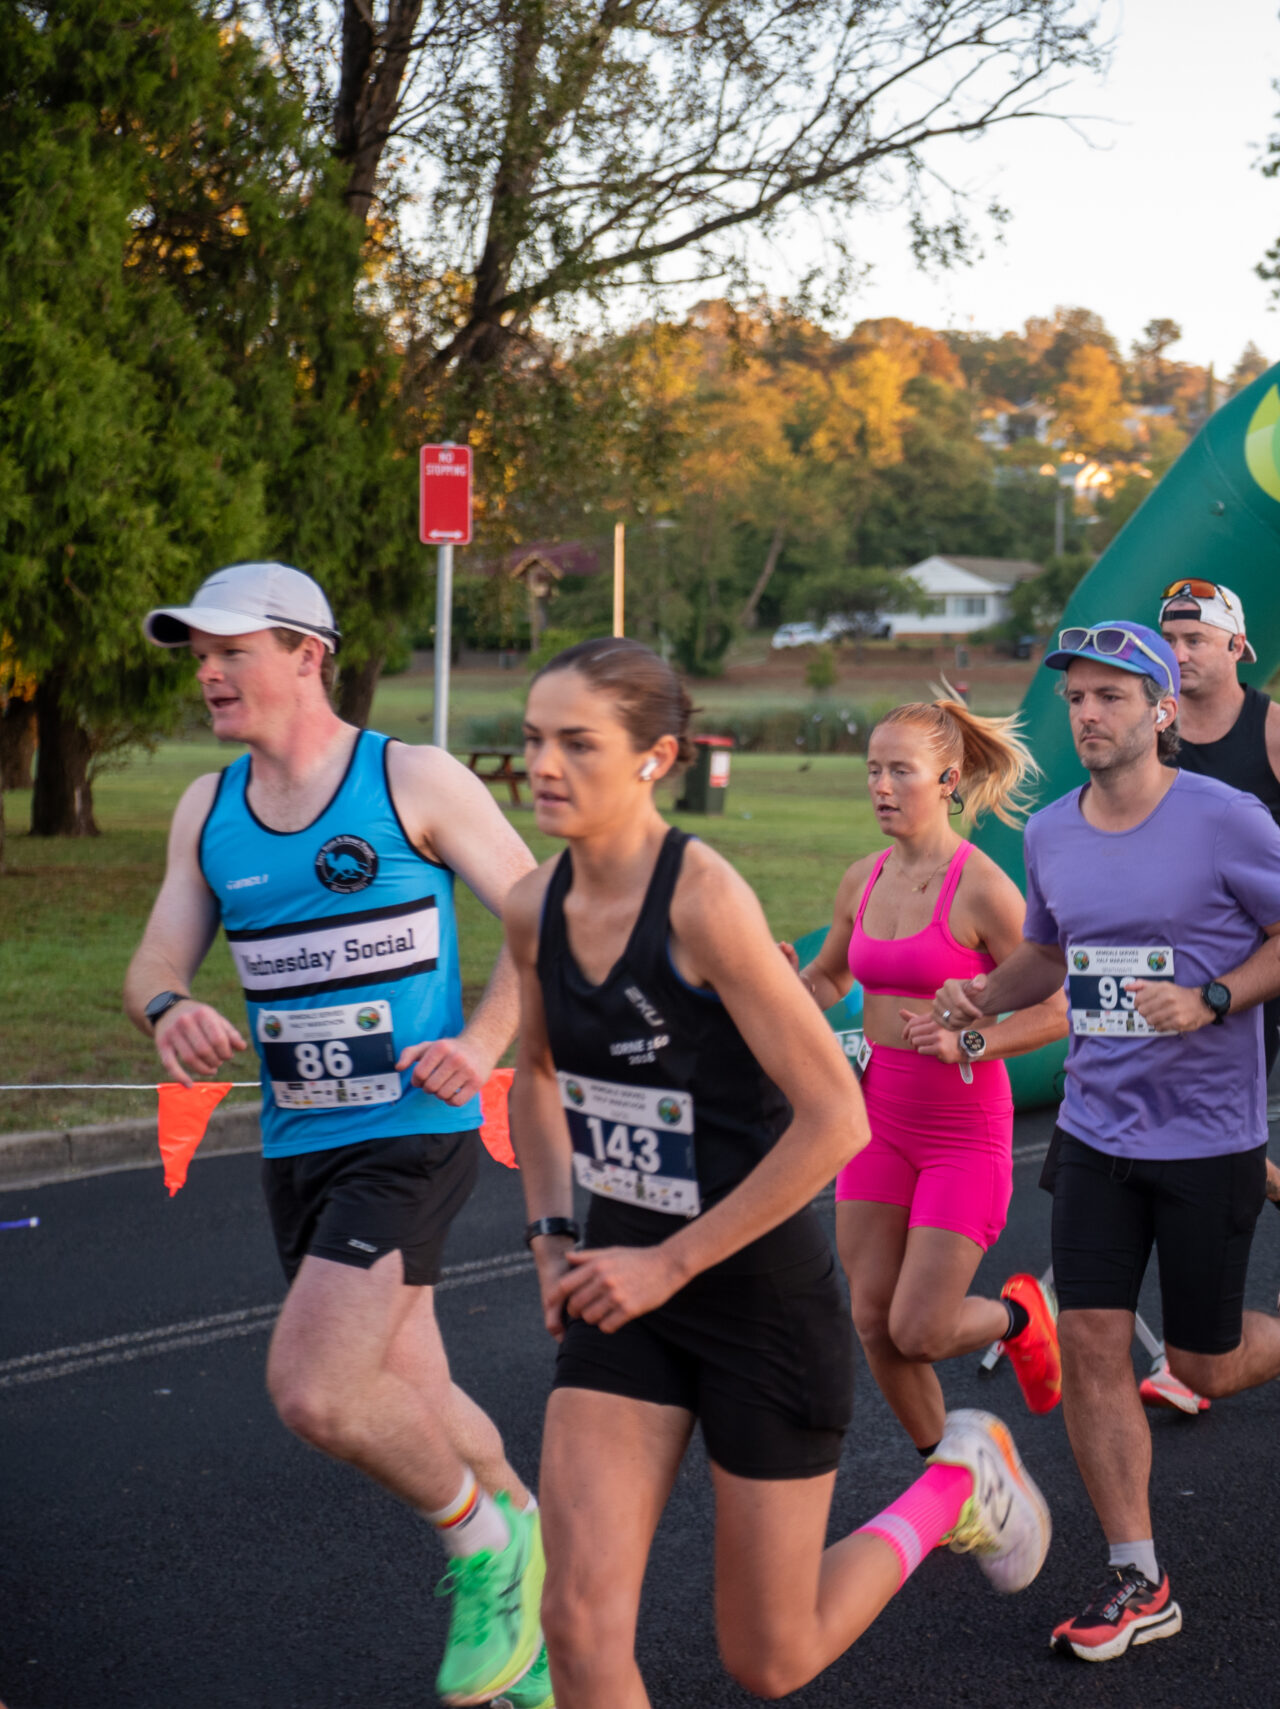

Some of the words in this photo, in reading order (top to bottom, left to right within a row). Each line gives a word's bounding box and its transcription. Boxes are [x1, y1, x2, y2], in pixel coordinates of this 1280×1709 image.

[425, 463, 467, 477] STOPPING
[438, 450, 455, 463] NO
[344, 928, 415, 963] Social
[293, 1040, 353, 1080] 86
[586, 1116, 662, 1175] 143
